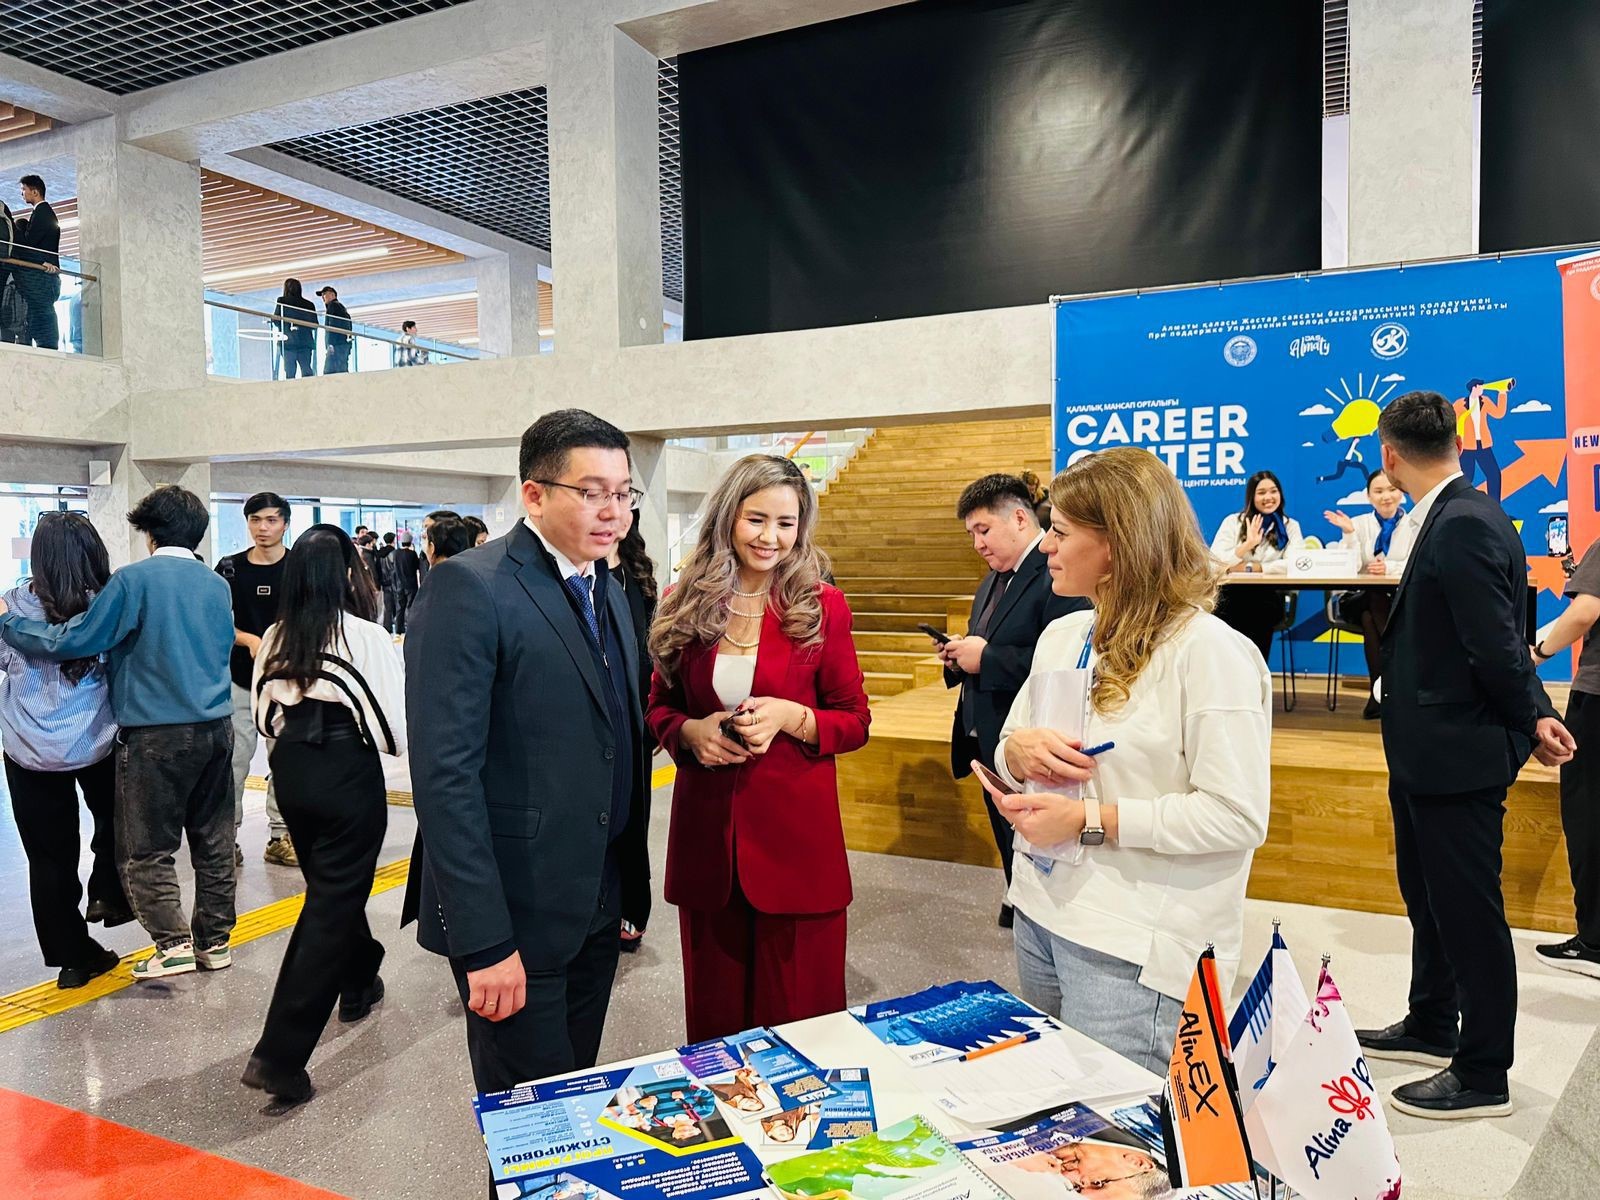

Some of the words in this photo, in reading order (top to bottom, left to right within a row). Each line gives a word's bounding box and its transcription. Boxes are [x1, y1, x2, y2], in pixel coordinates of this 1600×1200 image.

[1148, 332, 1167, 341] При
[1169, 327, 1223, 338] поддержке
[1227, 321, 1287, 333] Управления
[1292, 314, 1358, 327] молодежной
[1362, 309, 1415, 321] политики
[1420, 306, 1459, 317] города
[1463, 302, 1508, 313] Алматы
[1162, 323, 1198, 332] Алматы
[1242, 316, 1278, 326] Жастар
[1289, 336, 1330, 359] Almaty
[1066, 405, 1104, 414] ҚАЛАЛЫҚ
[1104, 402, 1136, 411] МАНСАП
[1136, 399, 1179, 409] ОРТАЛЫҒЫ
[1067, 405, 1249, 446] CAREER
[1574, 435, 1600, 449] NEW
[1184, 480, 1210, 488] ЦЕНТР
[1210, 478, 1246, 487] КАРЬЕРЫ
[1178, 1010, 1219, 1117] AlinEX
[501, 1137, 611, 1165] СТАЖИРОВОК
[503, 1145, 614, 1175] ПРОГРАММЫ
[1304, 1117, 1352, 1180] Alina
[714, 1180, 733, 1188] Group
